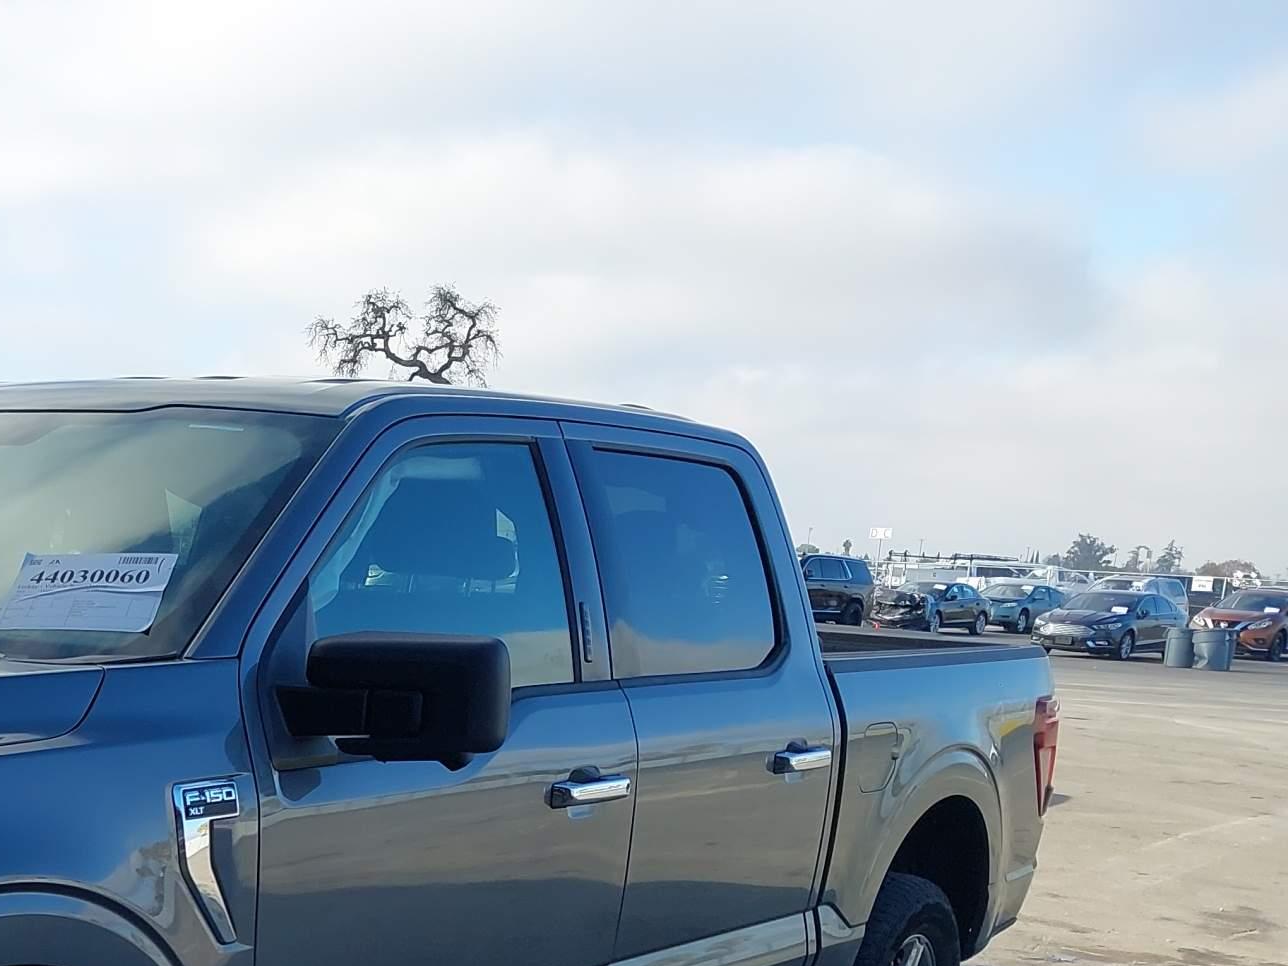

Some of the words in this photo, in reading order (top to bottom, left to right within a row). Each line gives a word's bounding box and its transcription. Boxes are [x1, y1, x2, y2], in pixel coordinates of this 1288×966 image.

[30, 568, 150, 584] 44030060
[185, 787, 236, 806] F-150
[188, 806, 205, 816] XLT
